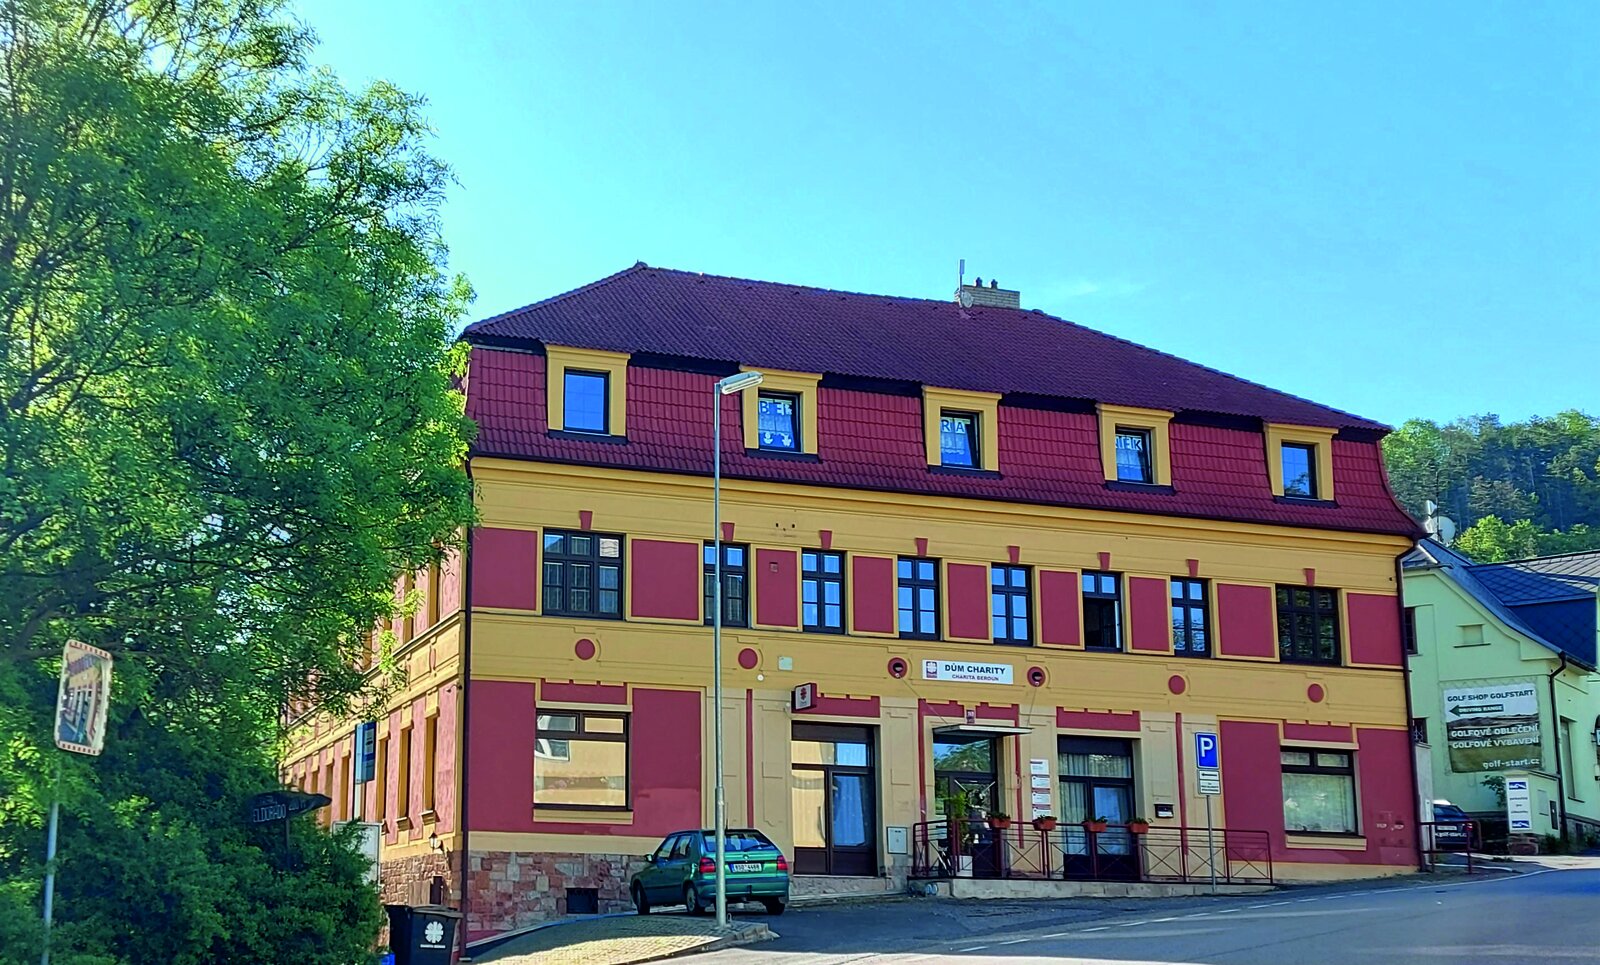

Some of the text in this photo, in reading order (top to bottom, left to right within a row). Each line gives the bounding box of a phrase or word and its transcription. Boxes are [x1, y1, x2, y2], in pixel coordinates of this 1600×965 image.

[945, 663, 1005, 674] DŮM CHARITY
[1490, 690, 1533, 699] GOLFSTART
[1451, 723, 1538, 738] GOLFOVÉ OBLEČENÍ
[1200, 737, 1213, 757] P
[1452, 736, 1539, 749] GOLFOVÉ VYBAVENÍ
[1483, 758, 1540, 769] golf-start.cz
